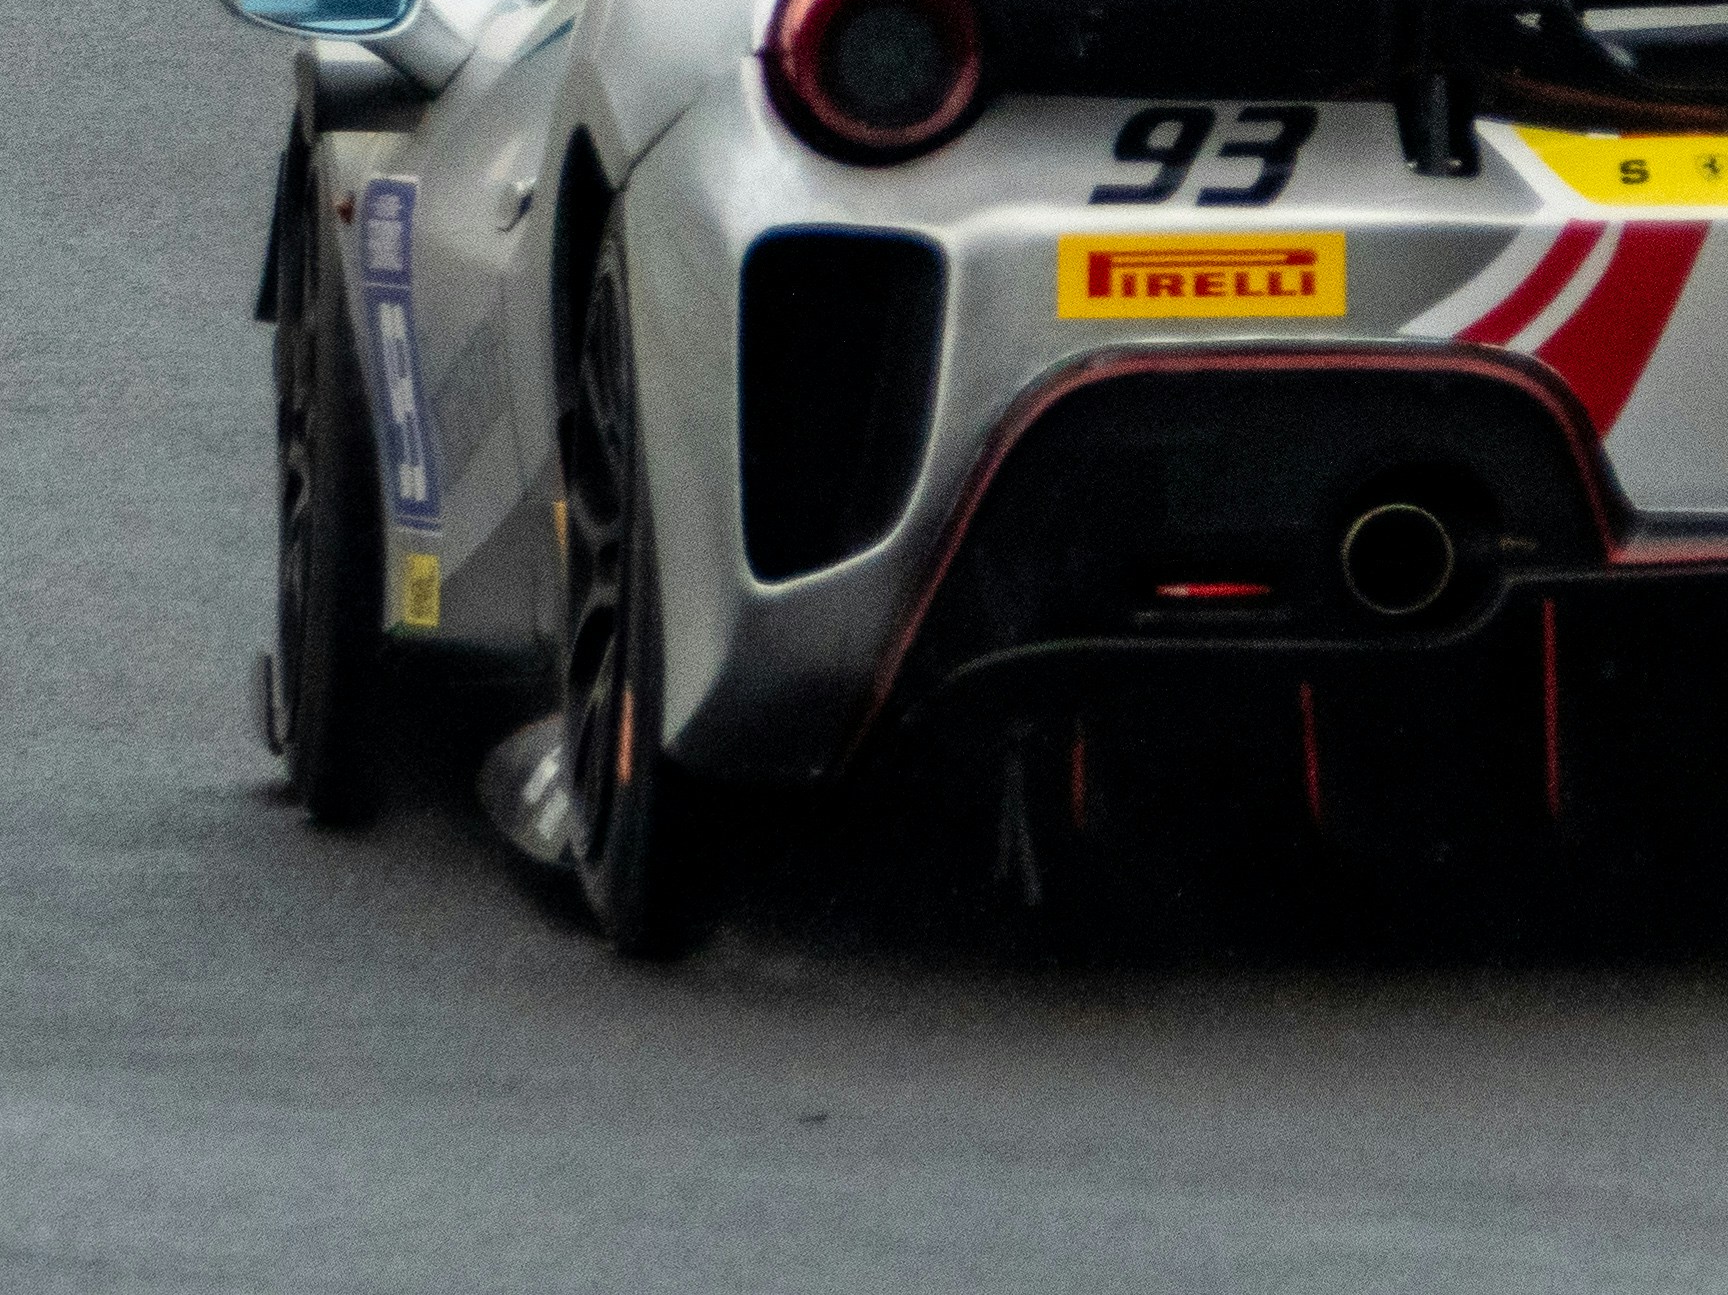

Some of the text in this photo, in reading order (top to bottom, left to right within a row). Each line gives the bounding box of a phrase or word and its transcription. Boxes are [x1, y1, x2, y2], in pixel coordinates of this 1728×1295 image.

[1088, 106, 1318, 206] 93
[1619, 158, 1650, 185] S
[1087, 248, 1318, 298] PIRELLI
